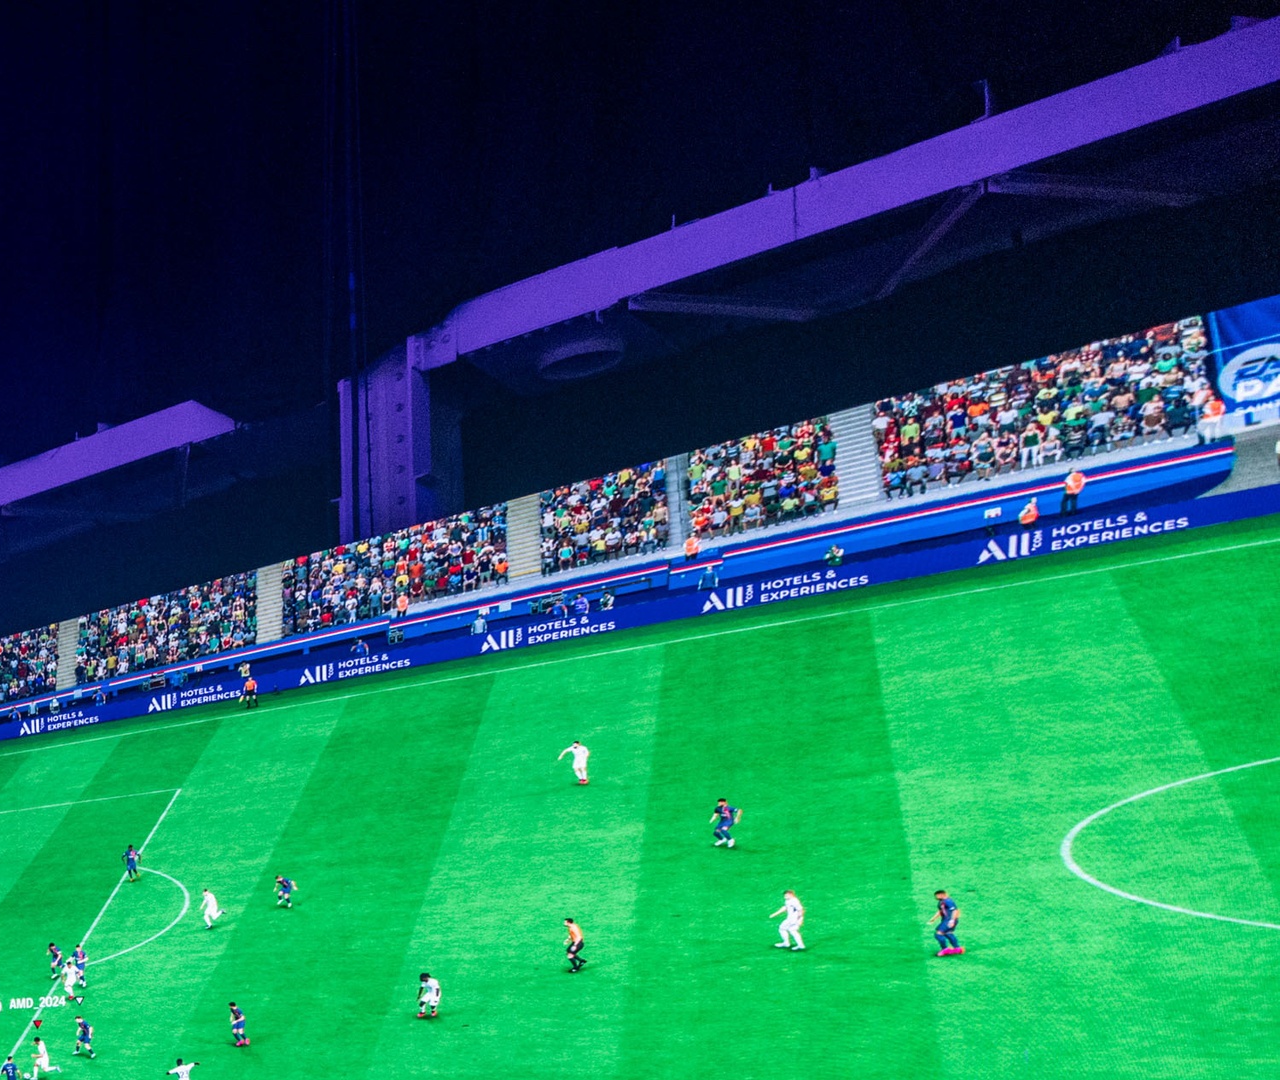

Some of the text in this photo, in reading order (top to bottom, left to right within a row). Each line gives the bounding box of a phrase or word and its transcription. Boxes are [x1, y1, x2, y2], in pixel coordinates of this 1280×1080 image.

[1051, 517, 1189, 551] EXPERIENCES
[1052, 512, 1148, 537] HOTELS &
[760, 575, 869, 602] EXPERIENCES
[761, 570, 836, 591] HOTELS &
[528, 616, 589, 634] HOTELS &
[528, 621, 616, 645] EXPERIENCES
[338, 653, 389, 669] HOTELS &
[338, 658, 411, 678] EXPERIENCES
[180, 690, 241, 707] EXPERIENCES
[181, 684, 223, 698] HOTELS &
[47, 712, 76, 723] HOTELS
[9, 995, 67, 1010] AMD_2024
